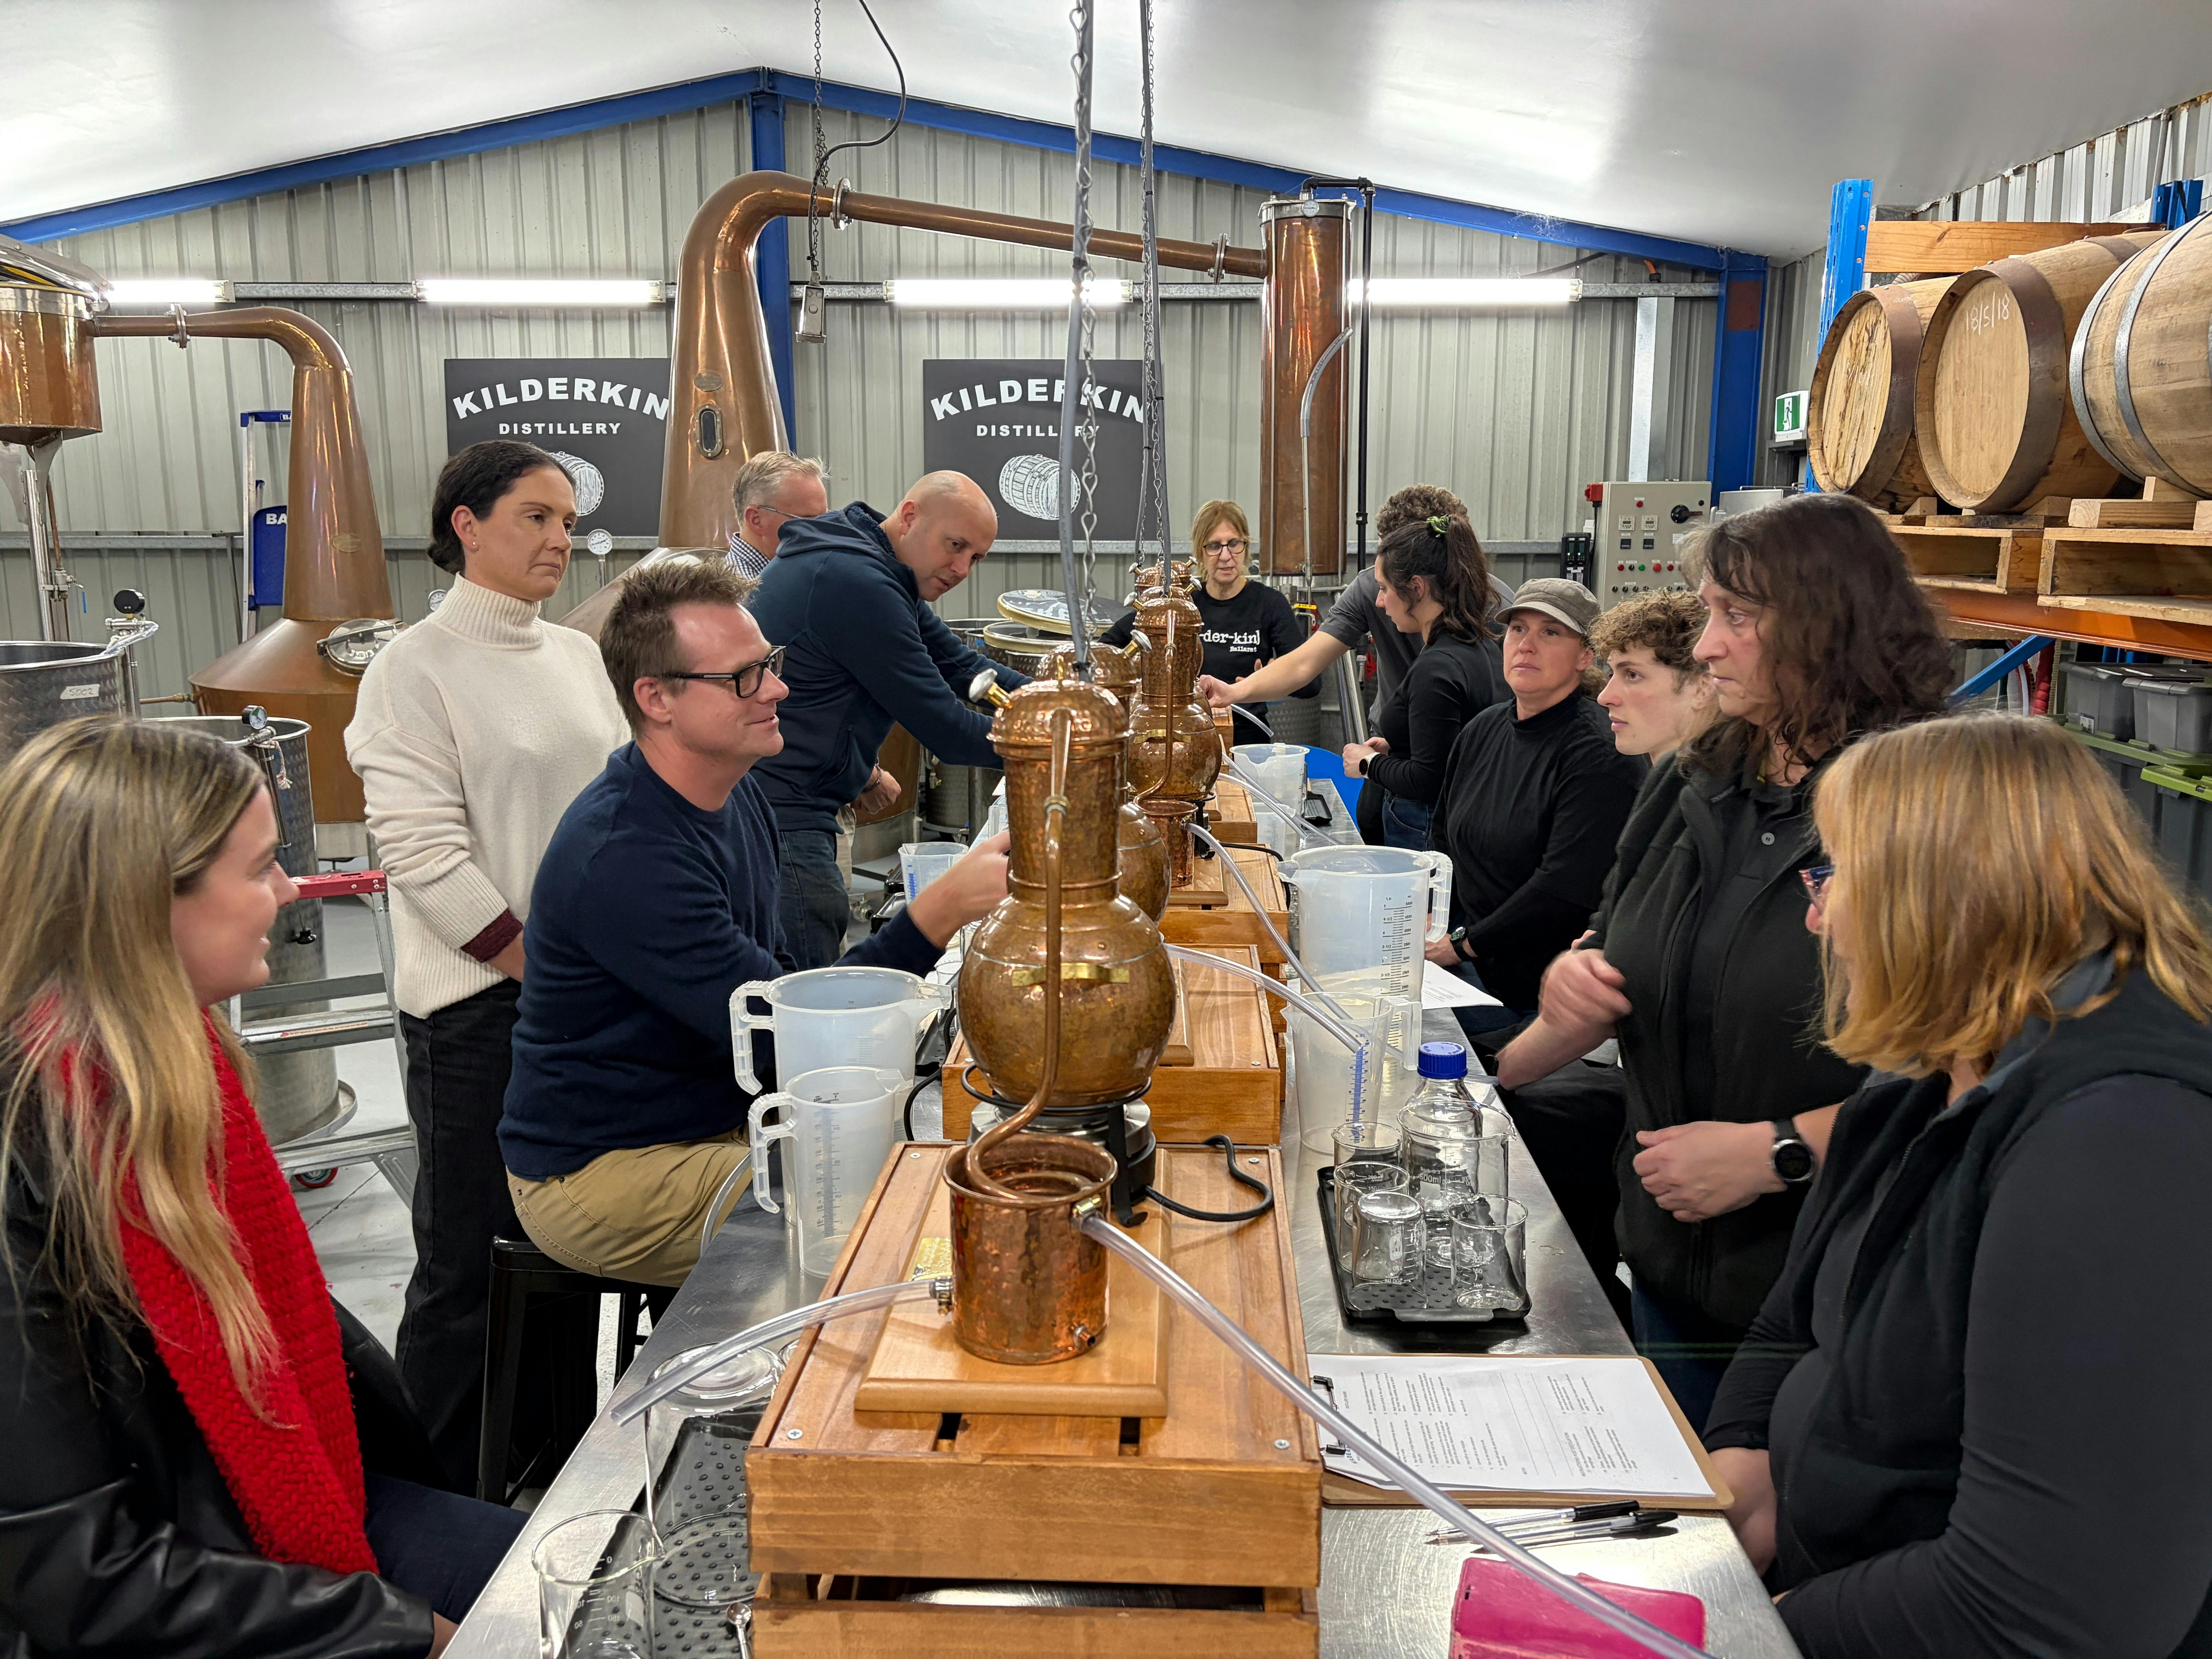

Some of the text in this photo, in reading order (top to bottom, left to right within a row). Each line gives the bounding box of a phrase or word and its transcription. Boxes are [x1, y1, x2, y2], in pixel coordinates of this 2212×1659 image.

[1966, 291, 2009, 336] 18/5/18
[453, 377, 670, 421] KILDERKIN
[499, 422, 621, 434] DISTILLERY
[976, 425, 1100, 437] DISTILLRY
[1419, 1174, 1441, 1183] 500ml
